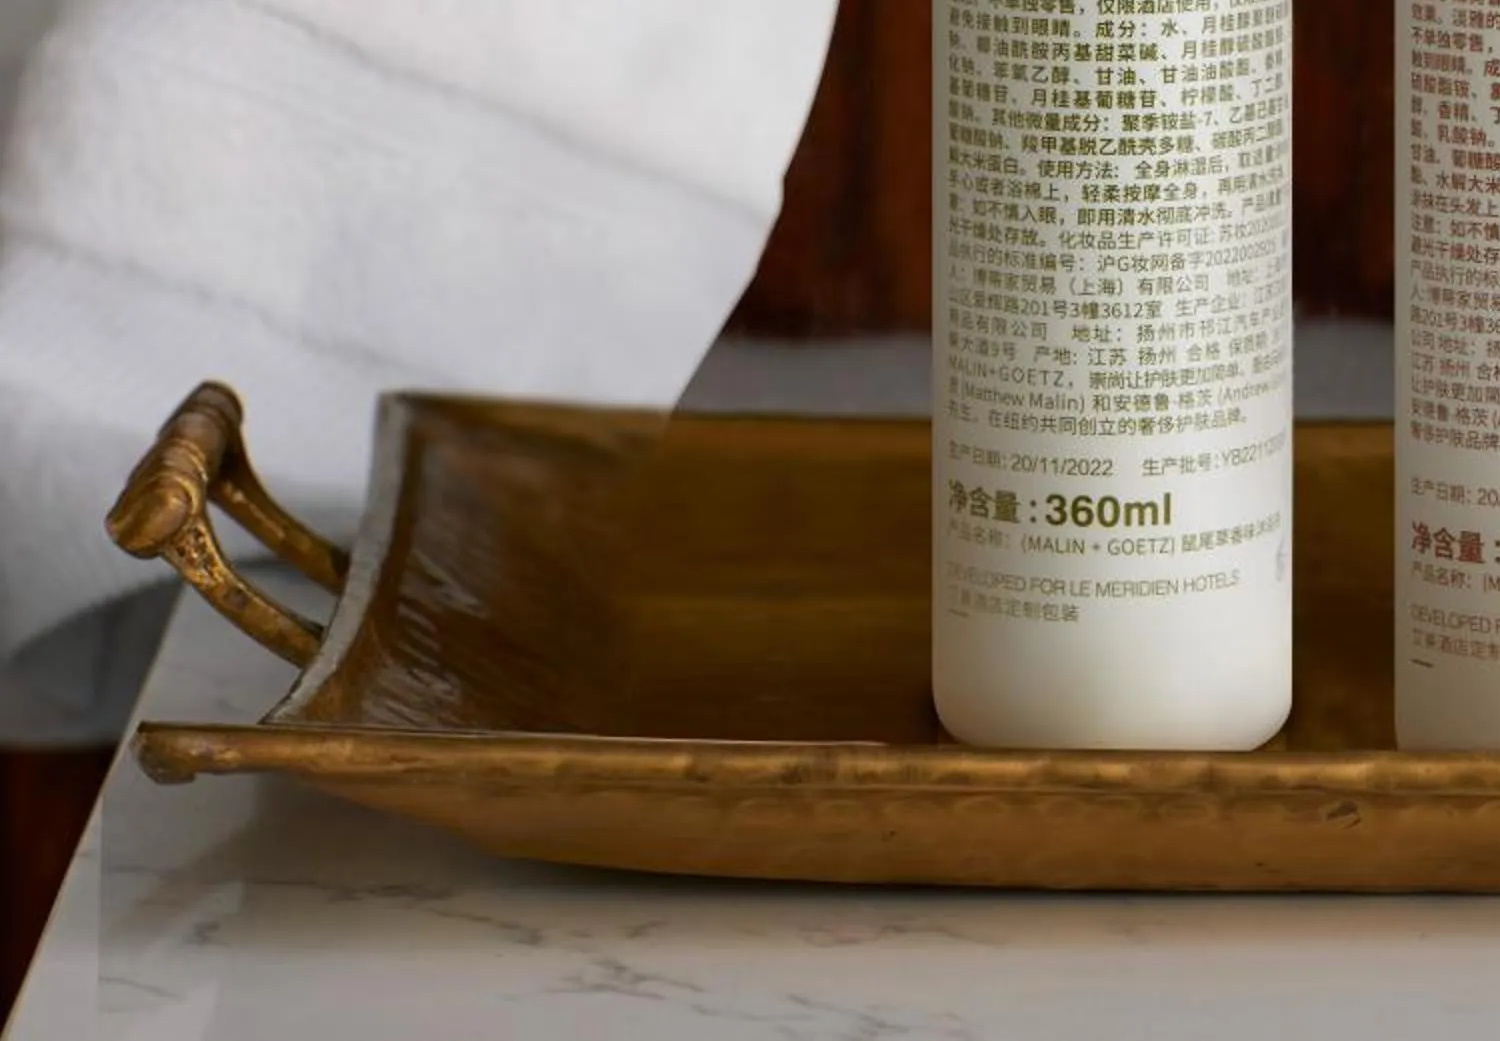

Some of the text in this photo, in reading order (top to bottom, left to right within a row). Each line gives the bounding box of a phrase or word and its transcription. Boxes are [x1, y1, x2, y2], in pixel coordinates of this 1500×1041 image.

[1029, 576, 1065, 596] FOR
[1070, 580, 1090, 597] LE
[1095, 577, 1179, 597] MERIDIEN
[1183, 568, 1241, 593] HOTELS
